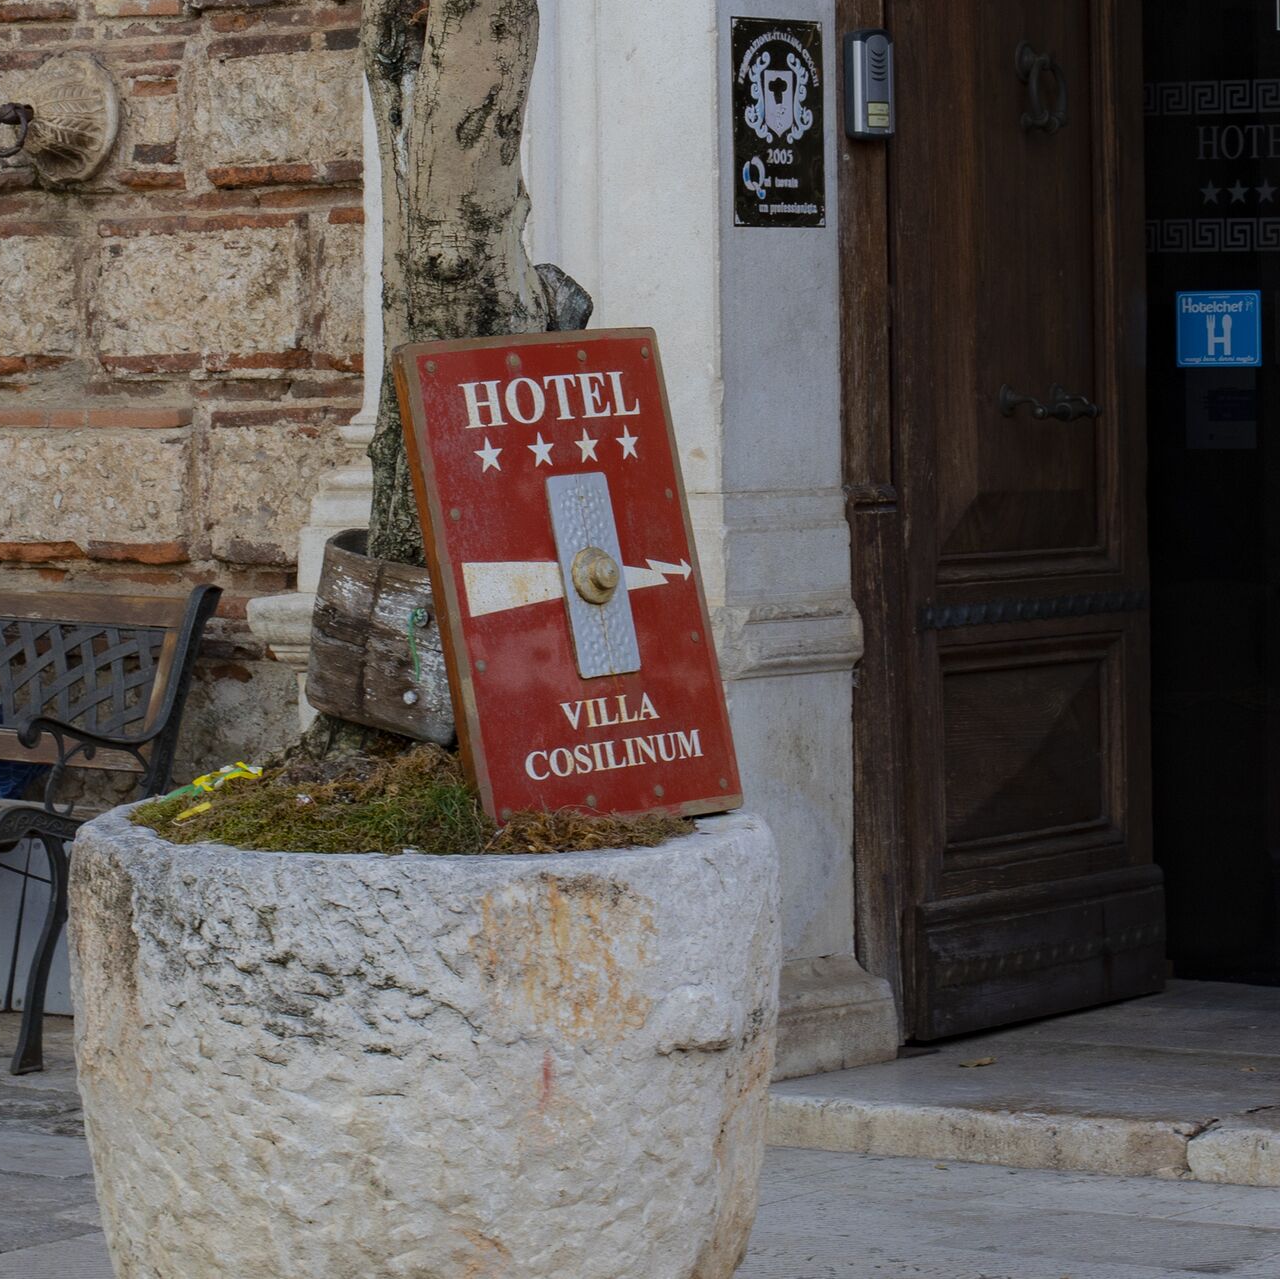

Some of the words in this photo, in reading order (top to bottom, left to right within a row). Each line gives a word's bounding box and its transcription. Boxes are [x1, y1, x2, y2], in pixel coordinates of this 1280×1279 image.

[766, 147, 793, 165] 2005
[1182, 297, 1244, 313] Hotelchef
[457, 370, 641, 430] HOTEL
[559, 691, 661, 731] VILLA
[524, 728, 705, 781] COSILINUM
